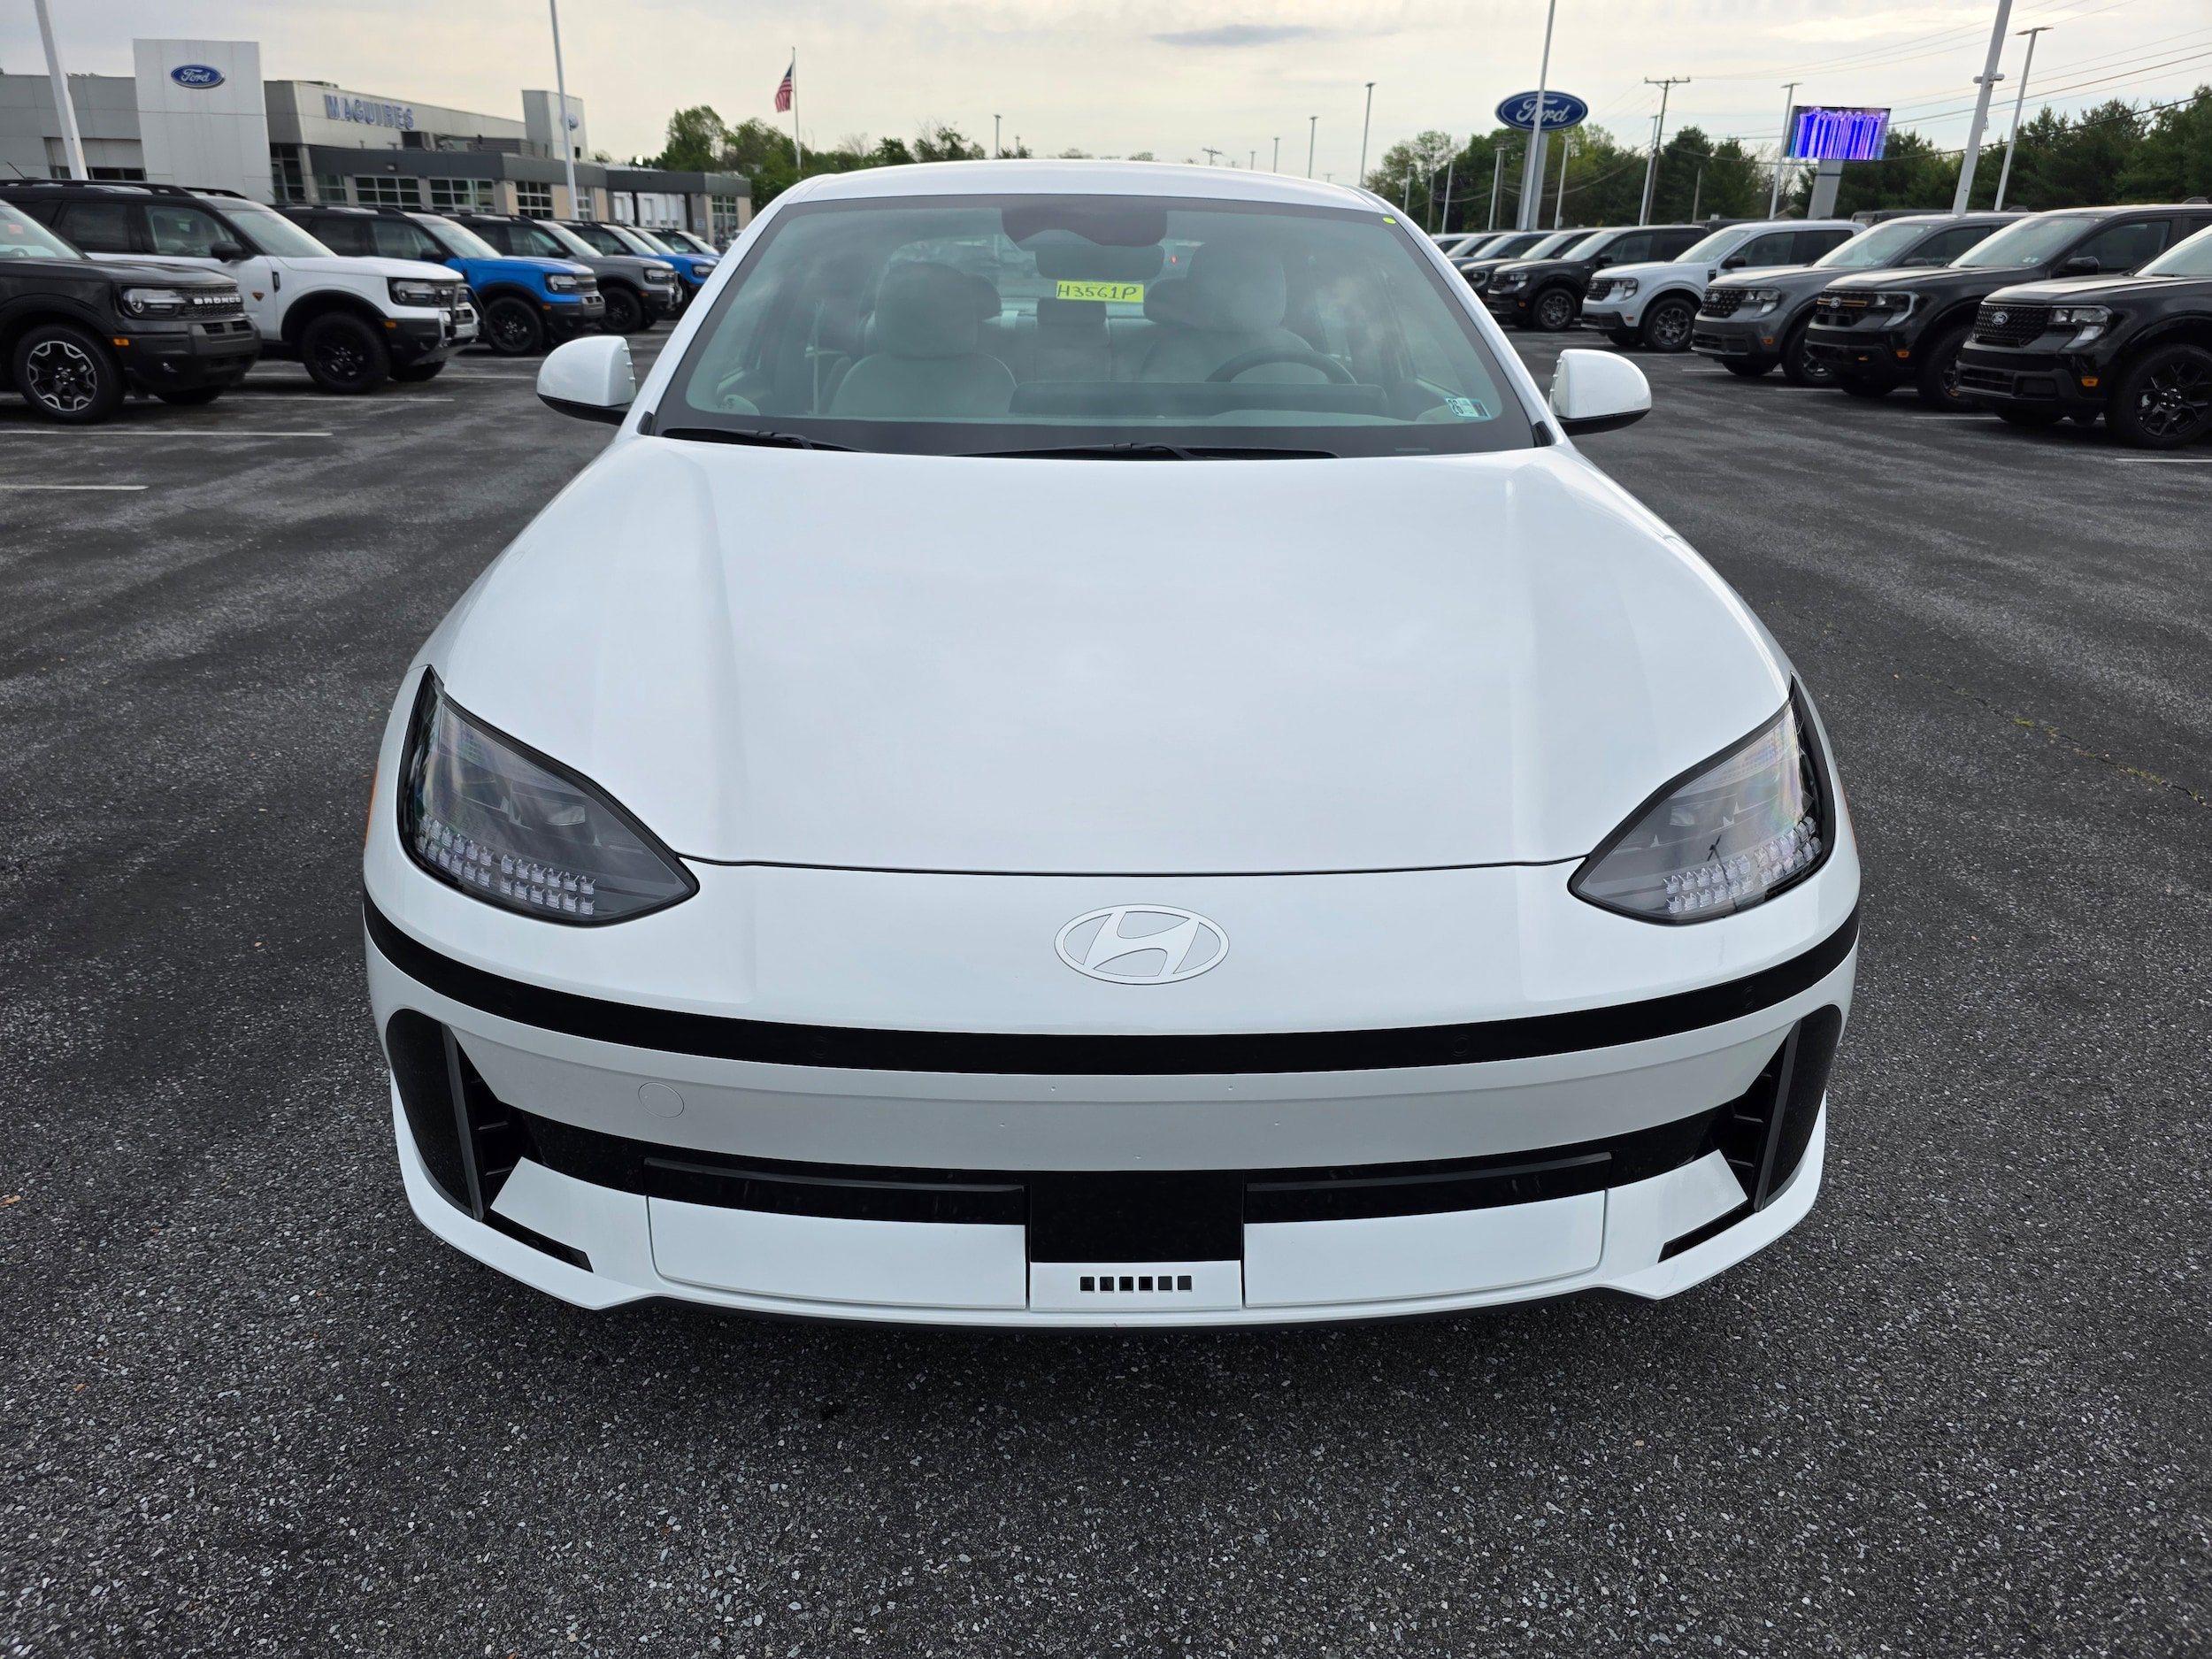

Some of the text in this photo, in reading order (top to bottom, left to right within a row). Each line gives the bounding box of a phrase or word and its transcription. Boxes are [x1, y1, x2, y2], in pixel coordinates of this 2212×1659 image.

[181, 69, 211, 81] Ford
[324, 95, 414, 130] MAGUIRES
[1516, 97, 1571, 122] Frd
[1057, 284, 1140, 300] H3561P
[194, 296, 242, 305] BRONCO
